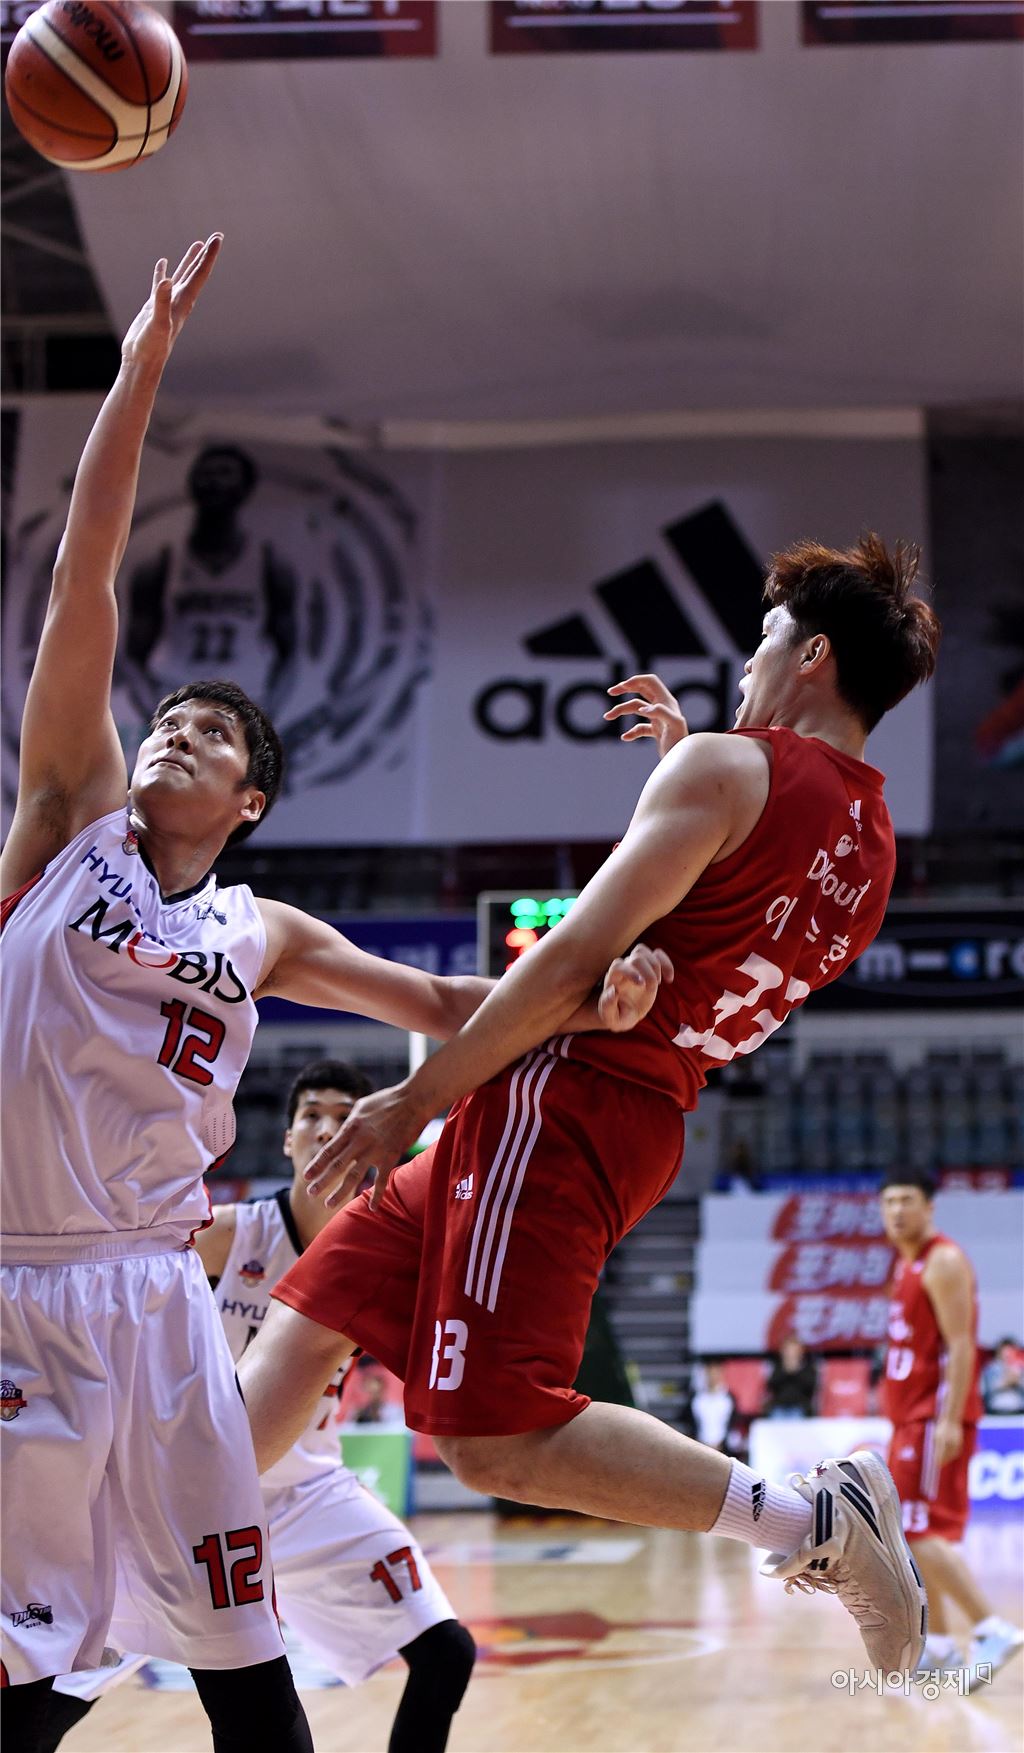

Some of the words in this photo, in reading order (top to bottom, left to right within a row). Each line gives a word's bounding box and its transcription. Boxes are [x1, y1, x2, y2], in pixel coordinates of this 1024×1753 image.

[69, 895, 247, 1004] MOBIS
[157, 998, 226, 1087] 12
[193, 1525, 264, 1610] 12
[370, 1547, 422, 1603] 17
